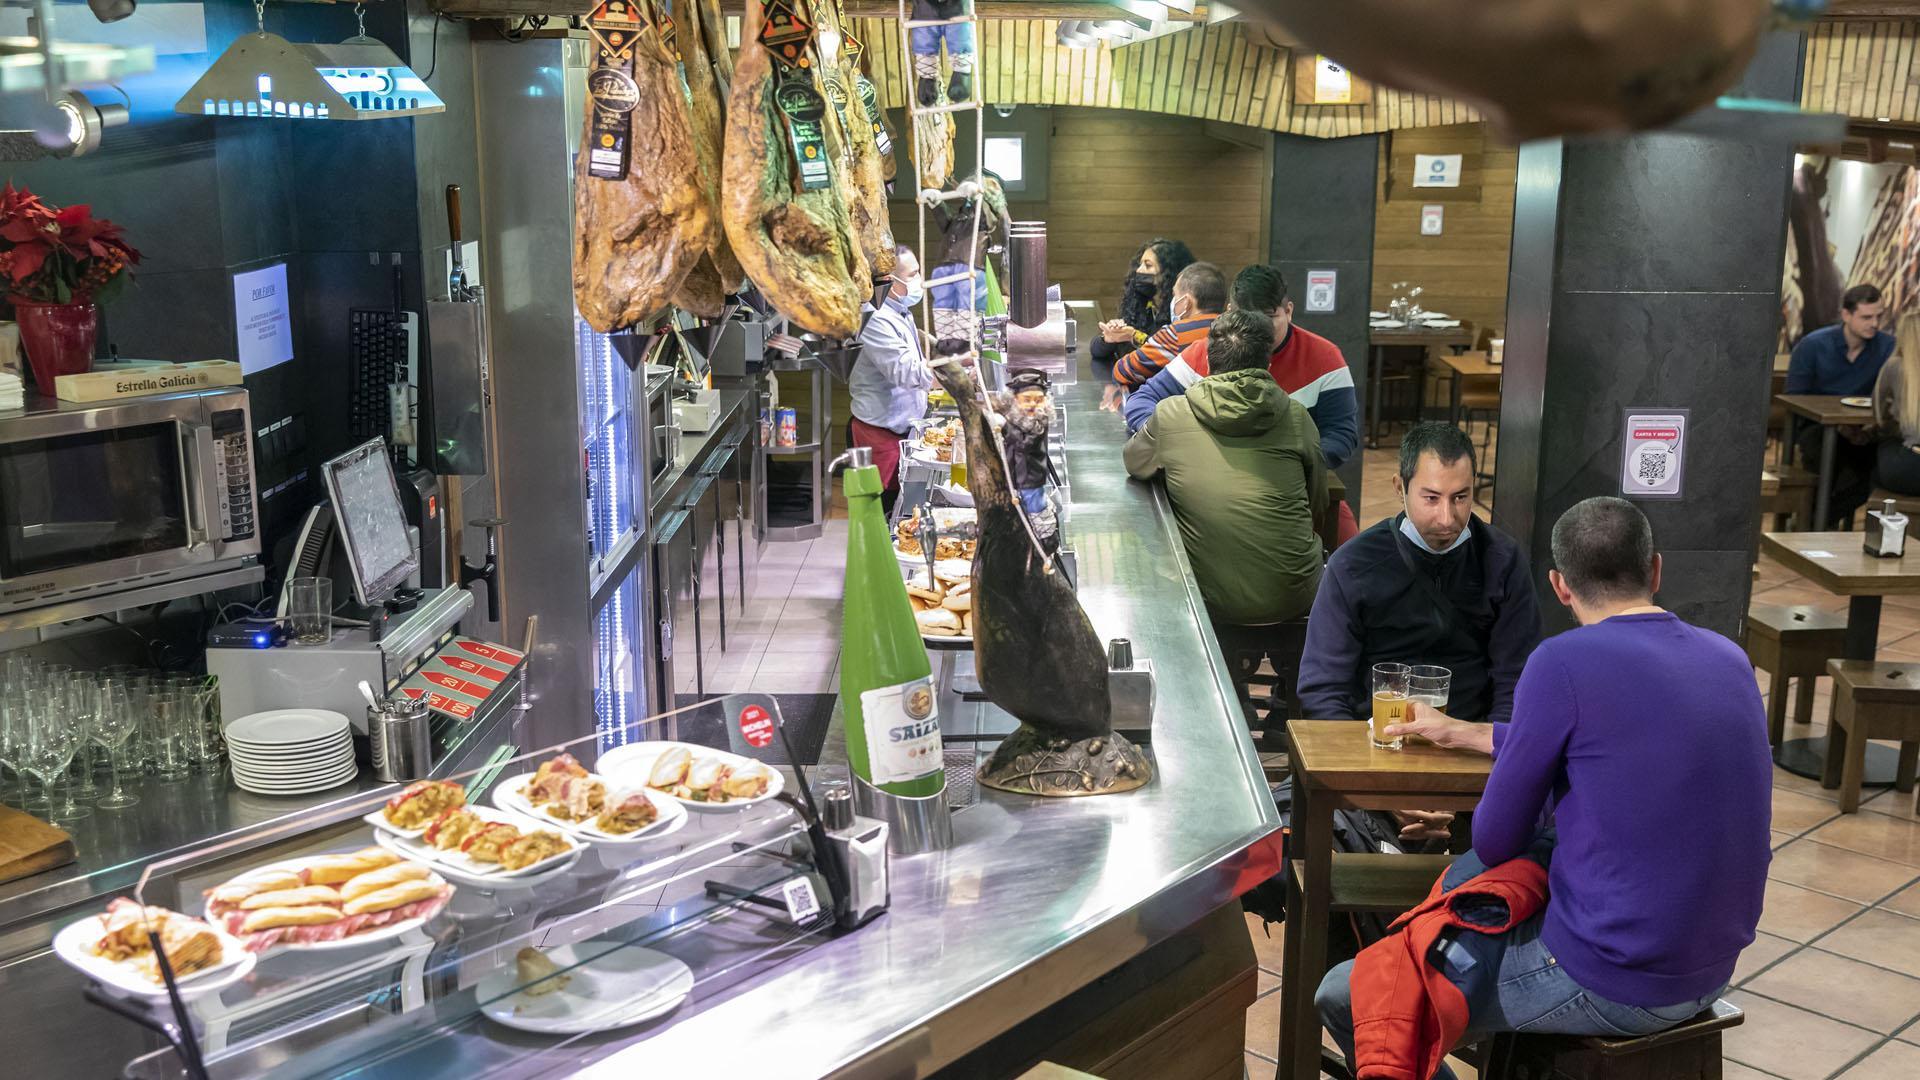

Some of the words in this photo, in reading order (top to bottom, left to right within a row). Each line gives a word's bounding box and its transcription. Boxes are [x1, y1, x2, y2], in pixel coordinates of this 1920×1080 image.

[116, 379, 157, 393] Estrella
[160, 374, 196, 389] Galicia
[475, 646, 490, 655] 5
[459, 661, 476, 670] 10
[440, 677, 459, 687] 20
[451, 702, 471, 714] 100
